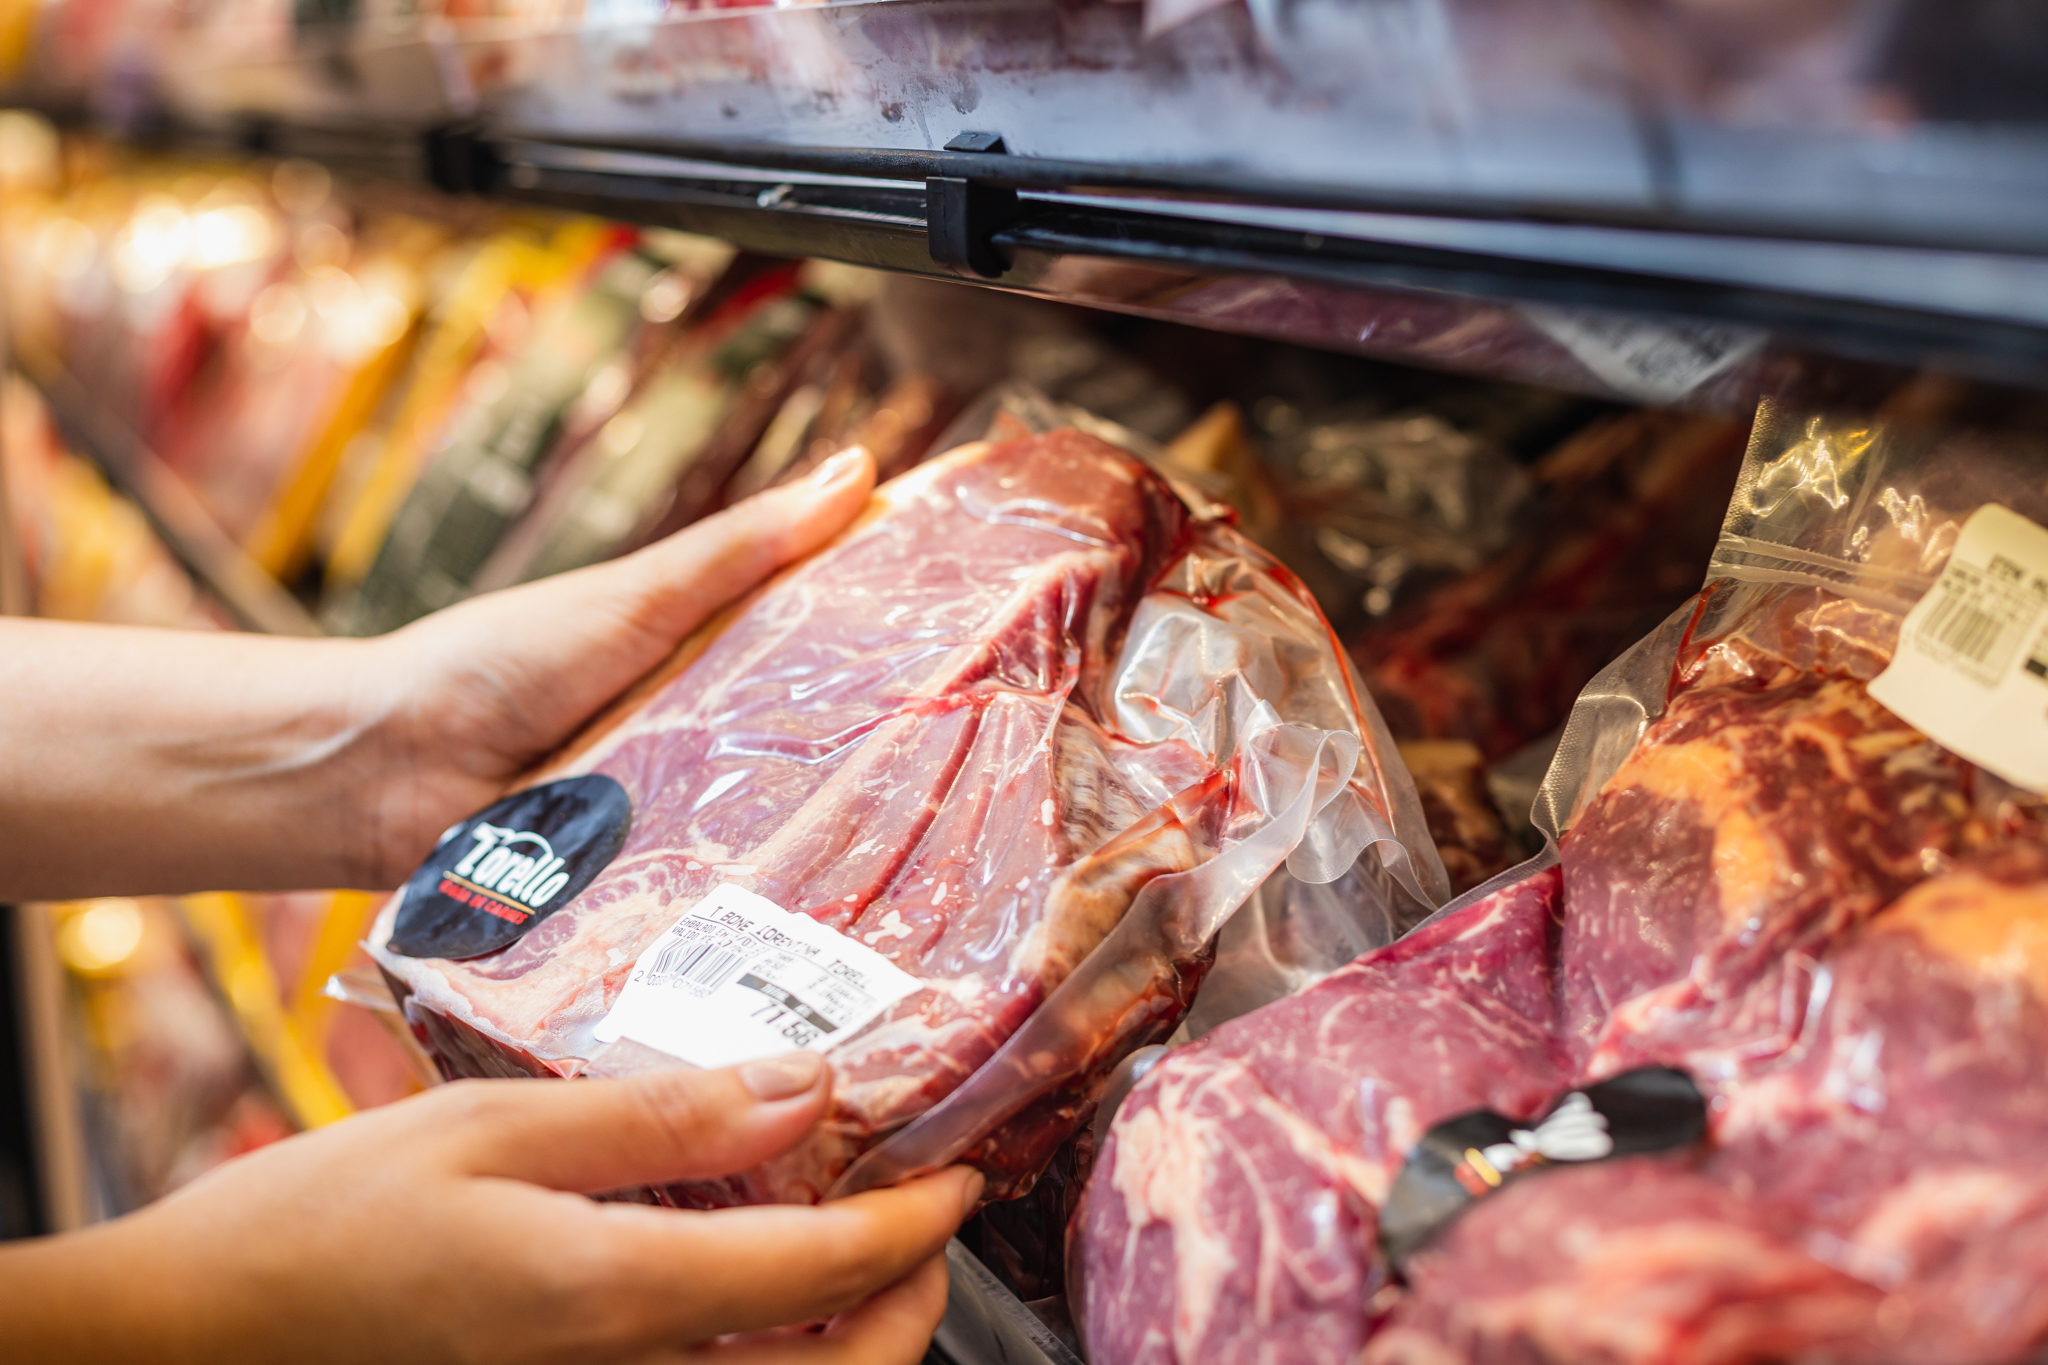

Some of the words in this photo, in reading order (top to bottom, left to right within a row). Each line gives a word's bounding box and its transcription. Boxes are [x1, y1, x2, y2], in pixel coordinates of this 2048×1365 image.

[454, 821, 570, 908] Torello
[680, 917, 717, 934] EMBALADO
[710, 905, 724, 918] T
[720, 911, 755, 932] BONE
[671, 925, 700, 941] VALIDO
[634, 970, 645, 983] 2
